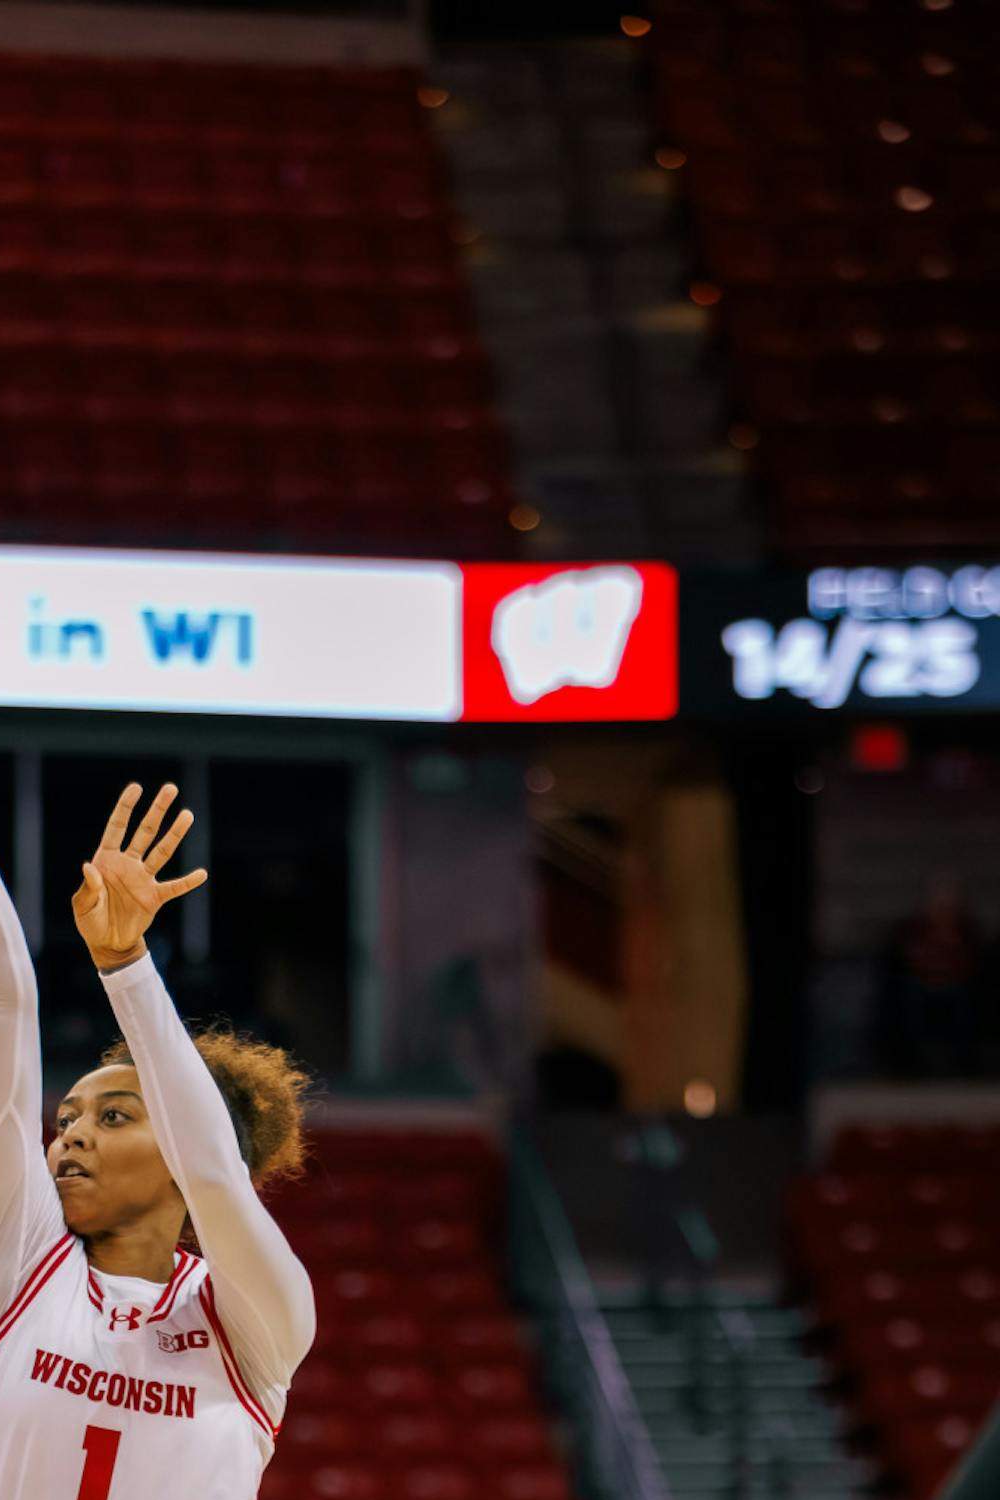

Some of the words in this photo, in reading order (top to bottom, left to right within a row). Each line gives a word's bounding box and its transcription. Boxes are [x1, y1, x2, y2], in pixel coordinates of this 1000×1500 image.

[29, 597, 105, 660] in
[141, 609, 256, 667] WI
[30, 1348, 197, 1419] WISCONSIN
